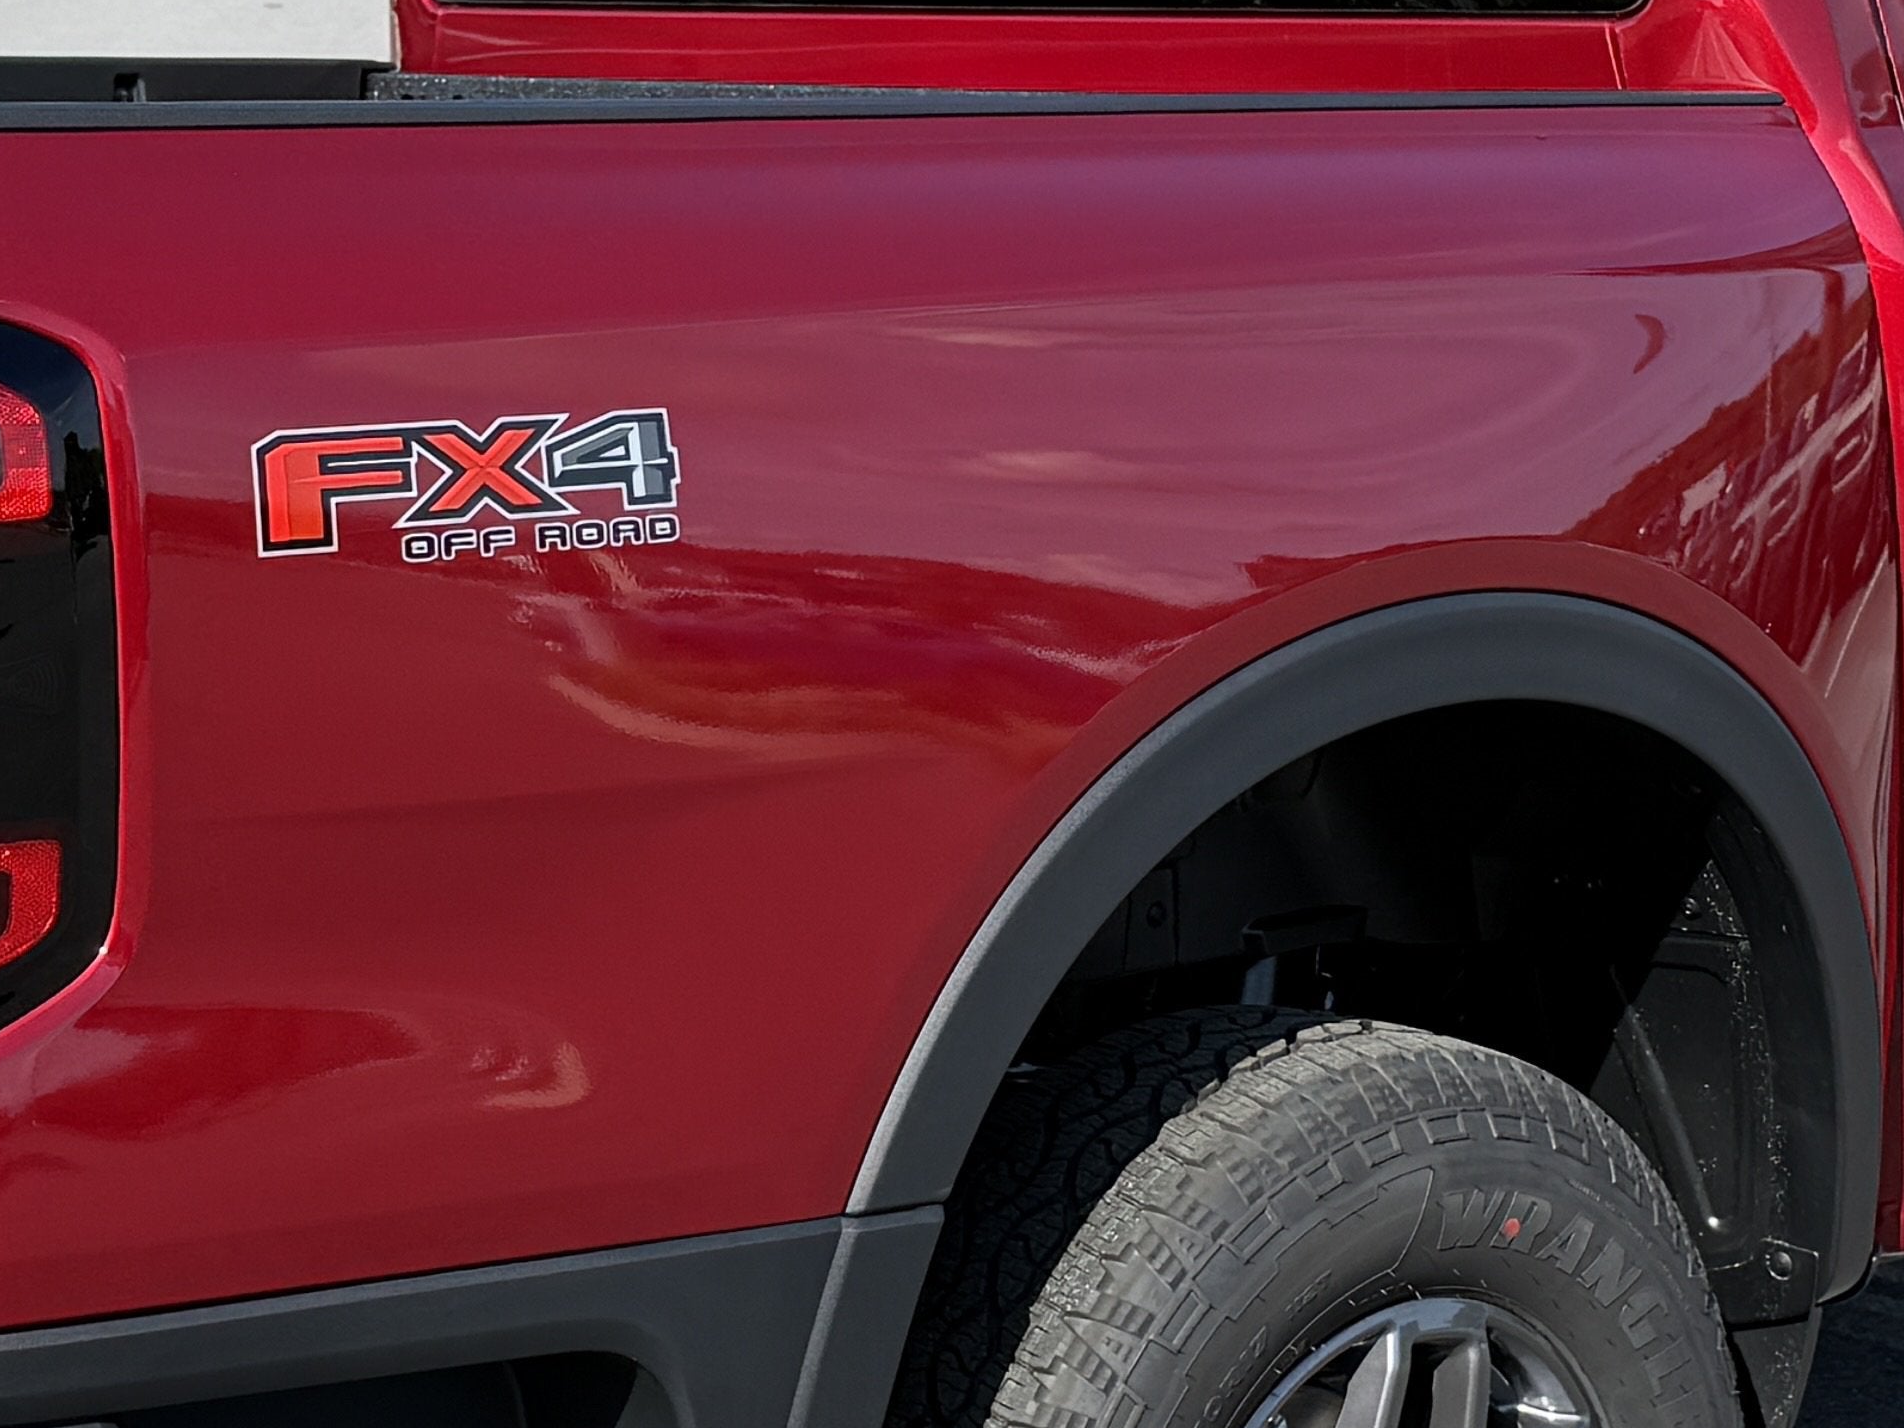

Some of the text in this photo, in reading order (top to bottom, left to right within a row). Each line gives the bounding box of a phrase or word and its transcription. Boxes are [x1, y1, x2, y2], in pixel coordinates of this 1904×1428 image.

[251, 407, 682, 558] FX4
[401, 513, 681, 563] OFF ROAD
